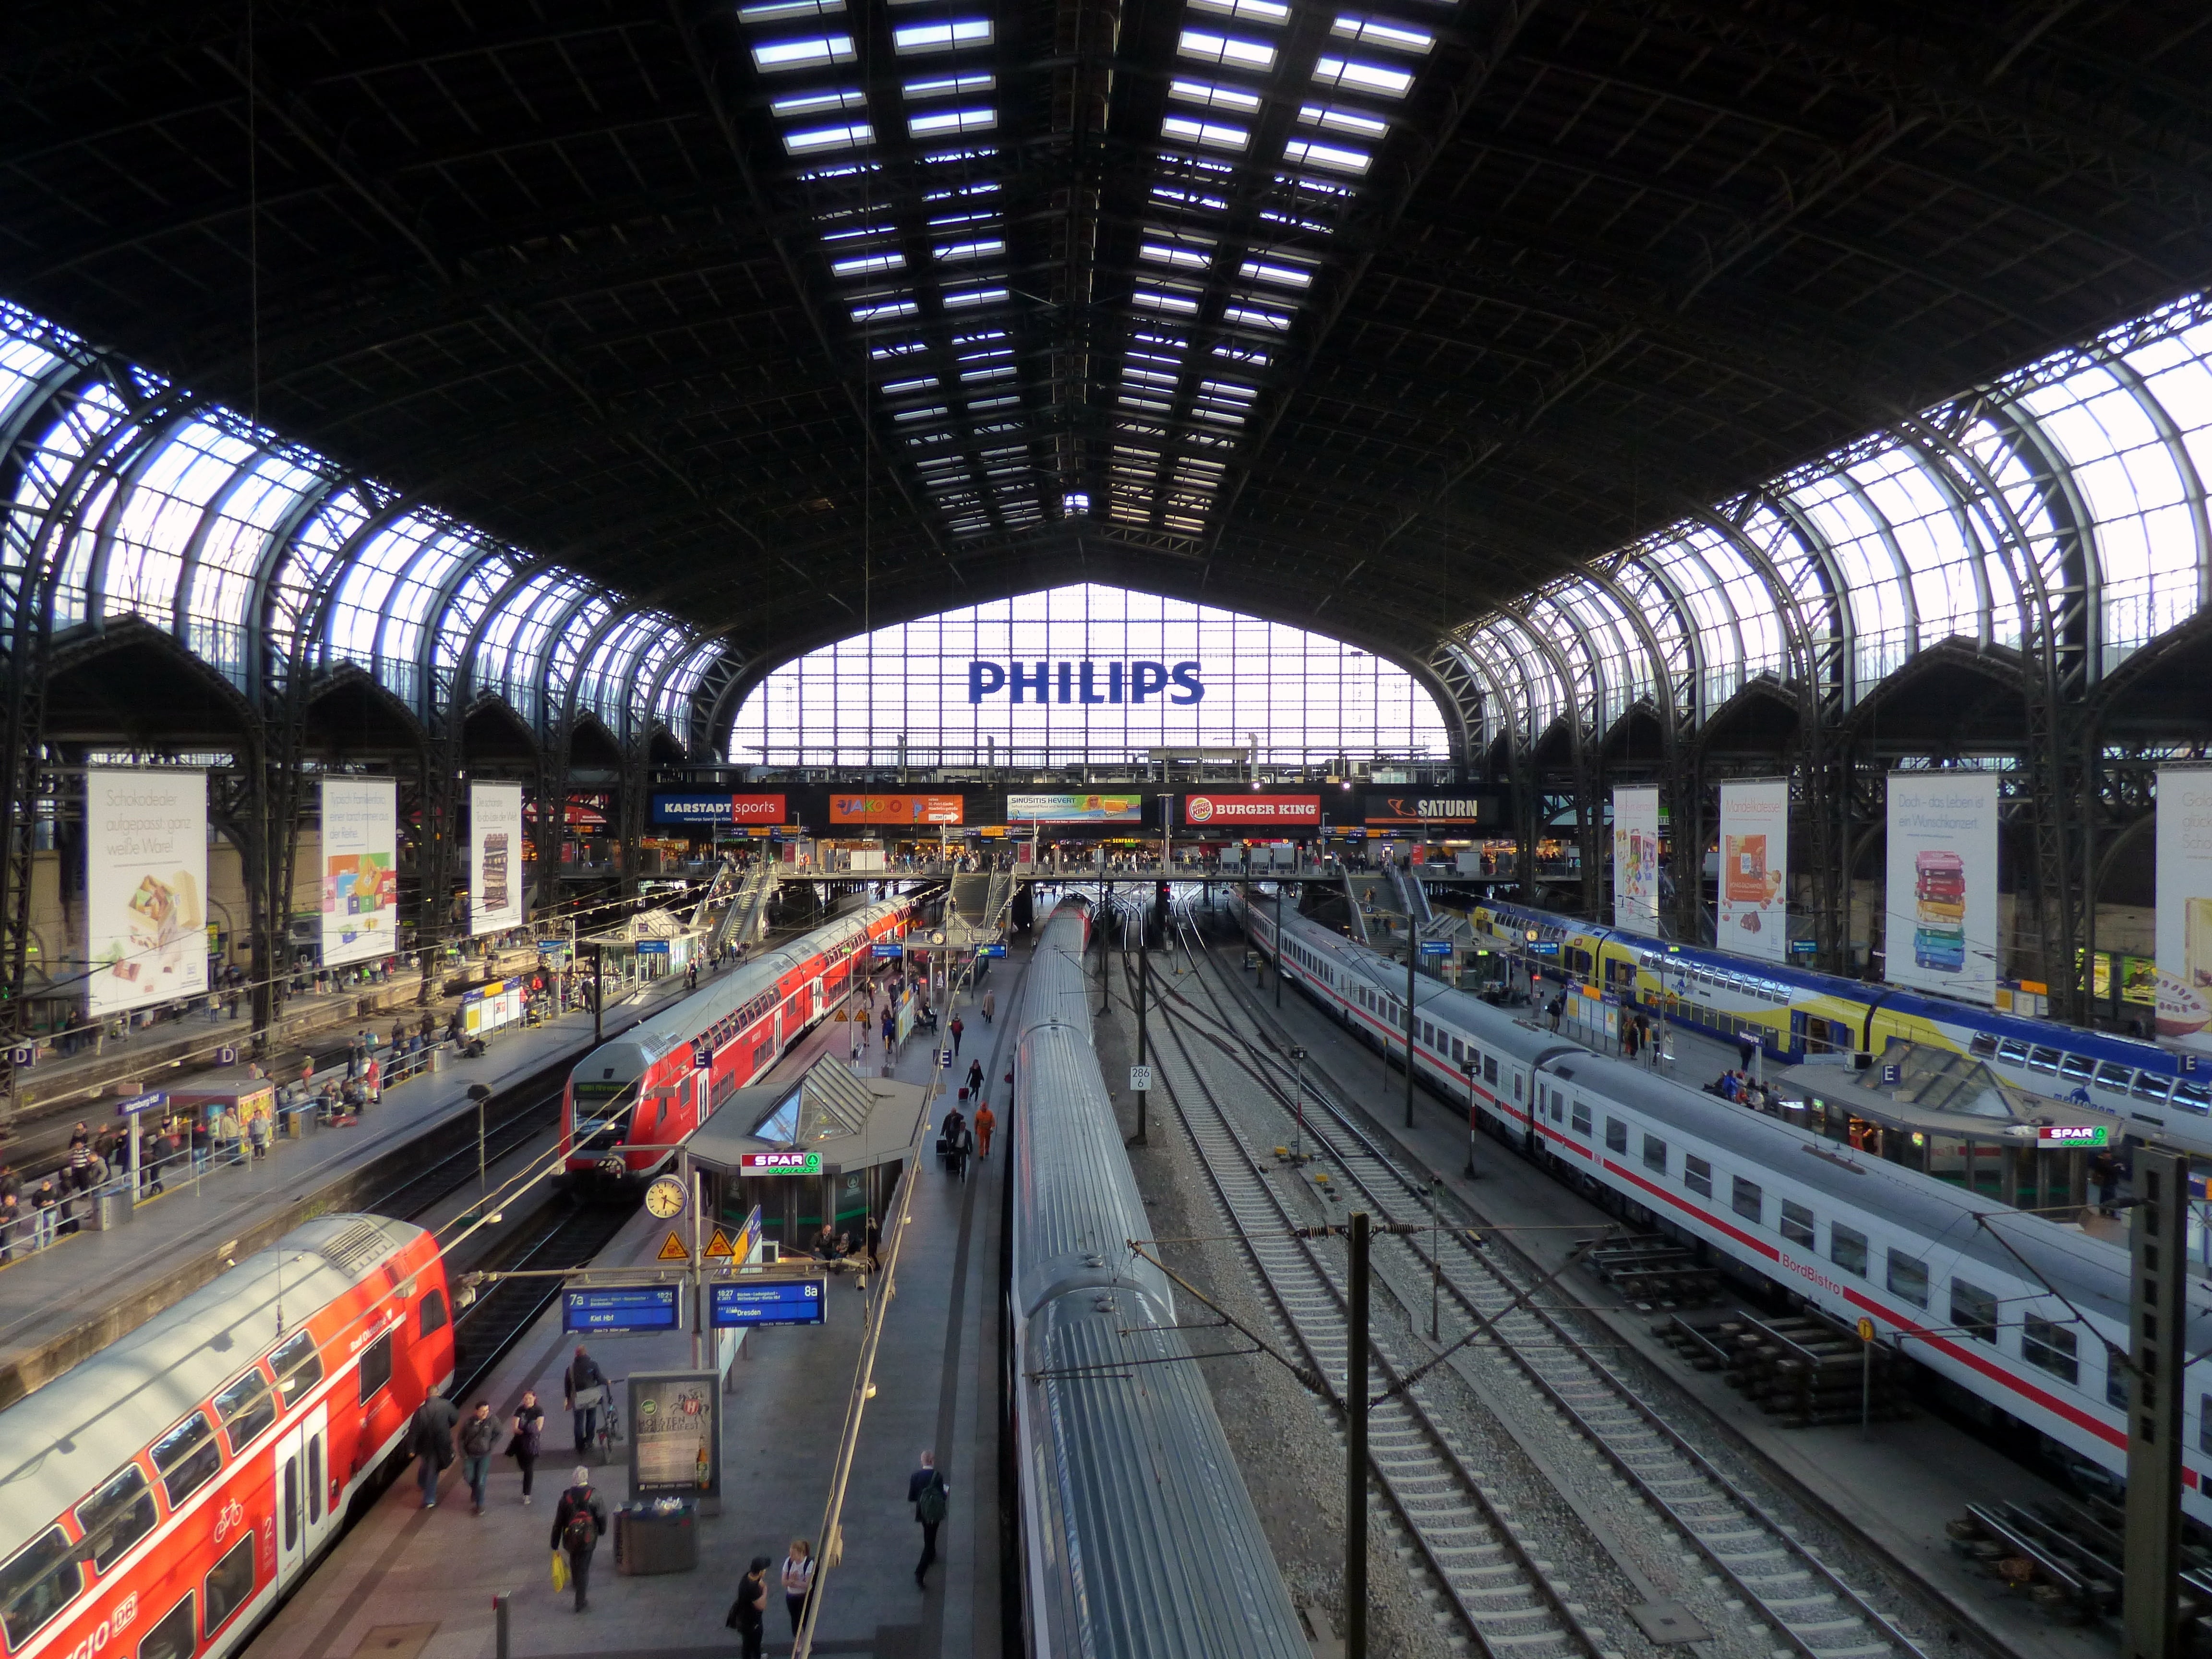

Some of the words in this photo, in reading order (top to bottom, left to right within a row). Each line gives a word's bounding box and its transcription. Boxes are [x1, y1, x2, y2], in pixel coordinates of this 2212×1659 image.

[969, 661, 1205, 704] PHILIPS
[107, 789, 177, 806] Schokodealer
[1899, 793, 1920, 807] Doch
[1929, 793, 1944, 808] das
[1946, 793, 1973, 808] Leben
[665, 804, 731, 813] KARSTADT
[735, 801, 775, 815] sports
[1192, 802, 1209, 811] BURGER
[1193, 806, 1210, 816] KING
[1216, 805, 1275, 815] BURGER
[1279, 805, 1316, 815] KING
[1418, 800, 1478, 817] SATURN
[1727, 797, 1781, 813] Mandelikatesse!
[168, 818, 191, 834] ganz
[1899, 815, 1911, 827] ein
[107, 837, 140, 856] weiße
[1740, 1031, 1753, 1042] Hamburg
[15, 1049, 27, 1063] D
[222, 1048, 234, 1062] D
[696, 1051, 705, 1065] E
[940, 1050, 949, 1064] E
[2186, 1056, 2196, 1070] E
[1132, 1068, 1150, 1077] 286
[1885, 1066, 1894, 1081] E
[1138, 1079, 1144, 1087] 6
[125, 1098, 149, 1112] Hamburg
[2054, 1093, 2115, 1115] metronom
[2051, 1128, 2092, 1138] SPAR
[755, 1155, 803, 1166] SPAR
[1783, 1253, 1840, 1295] BordBistro
[805, 1286, 817, 1297] 8a
[570, 1294, 584, 1306] 7a
[350, 1334, 362, 1352] Bad
[687, 1401, 696, 1412] H
[638, 1416, 685, 1428] HOLSTEN
[264, 1516, 272, 1540] 2
[65, 1620, 110, 1659] GIO
[117, 1600, 134, 1628] DB
